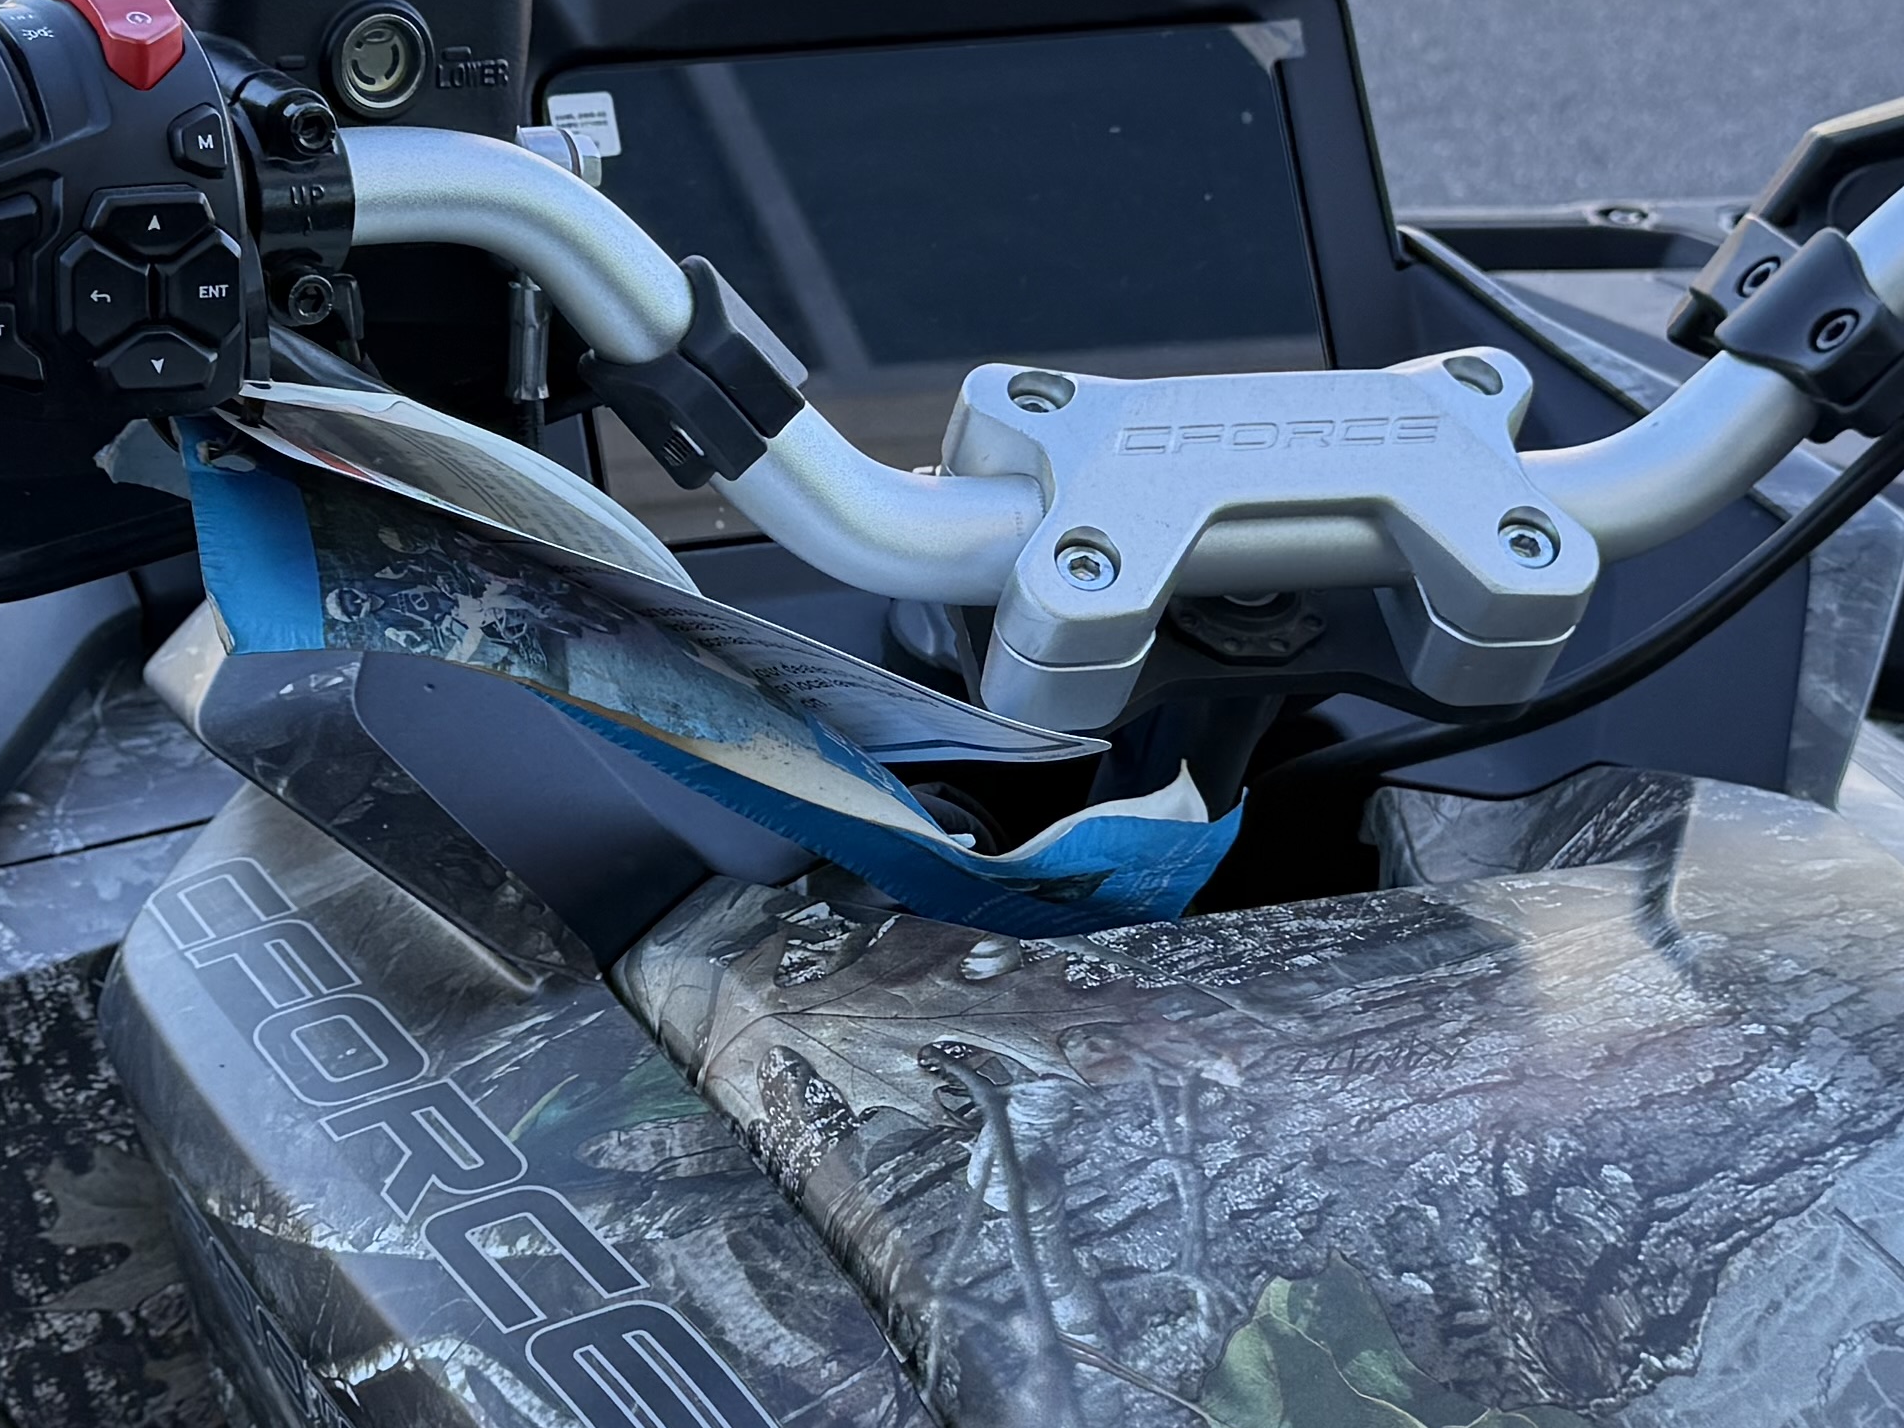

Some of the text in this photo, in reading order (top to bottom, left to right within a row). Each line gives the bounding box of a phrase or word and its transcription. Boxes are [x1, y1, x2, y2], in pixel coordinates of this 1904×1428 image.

[436, 59, 509, 88] LOWER
[198, 135, 213, 150] M
[290, 185, 325, 207] UP
[199, 284, 229, 300] ENT
[1117, 415, 1439, 456] CFORCE
